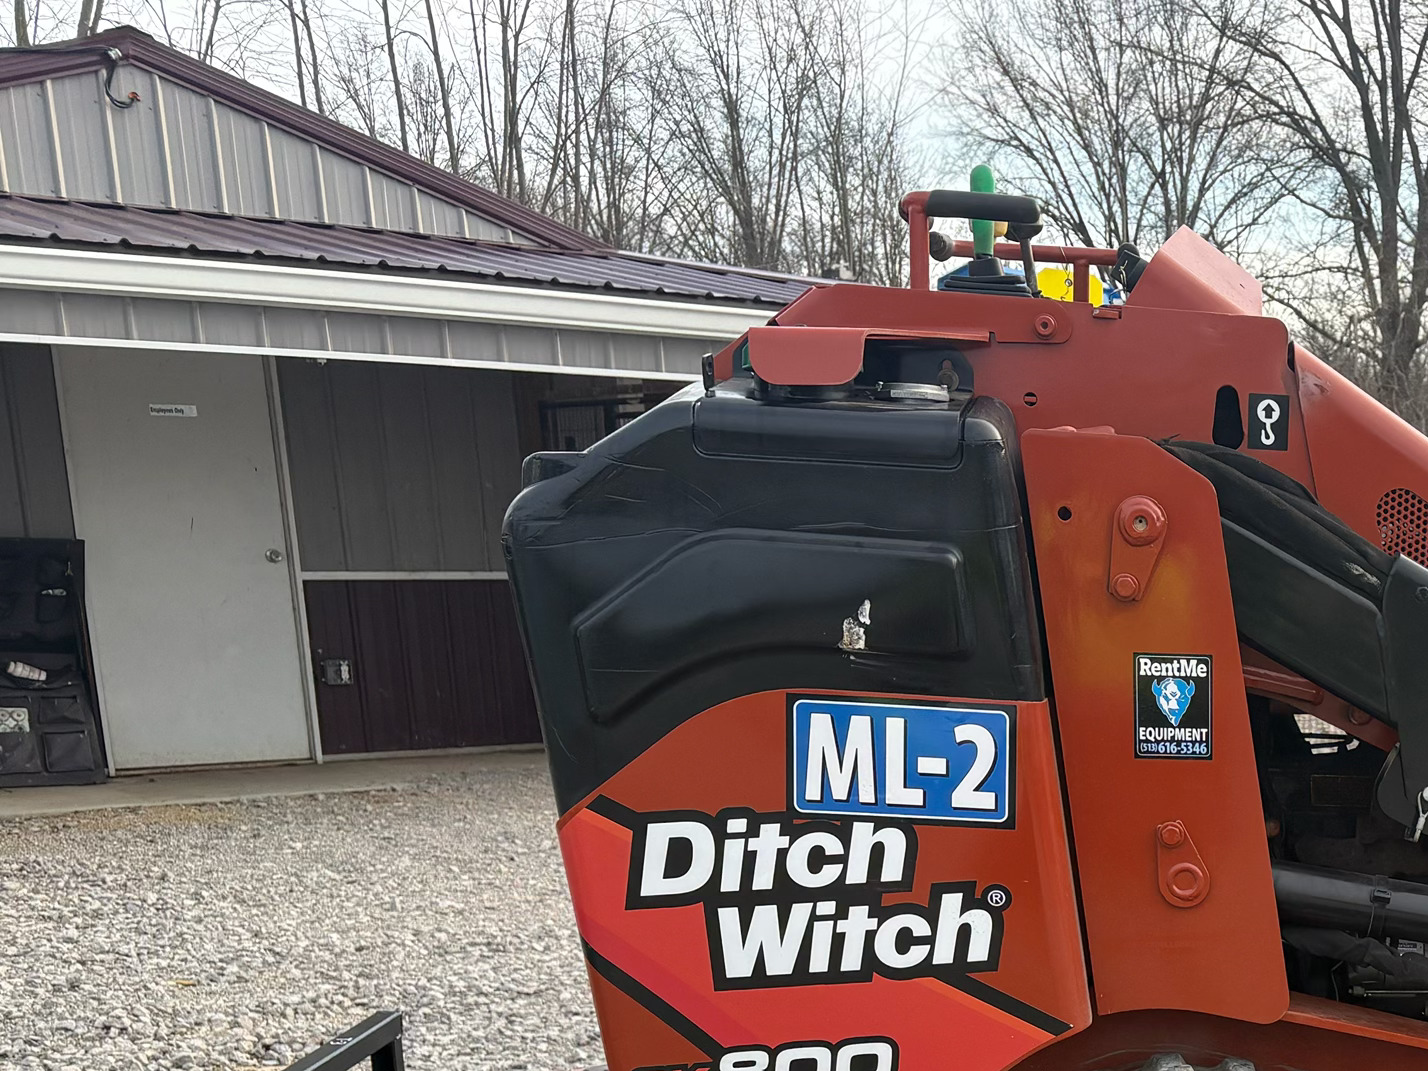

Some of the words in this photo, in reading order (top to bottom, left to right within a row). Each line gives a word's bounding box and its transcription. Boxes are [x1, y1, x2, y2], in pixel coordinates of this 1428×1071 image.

[1139, 658, 1208, 677] RentMe
[1139, 727, 1208, 742] EQUIPMENT
[805, 712, 998, 812] ML-2
[639, 817, 907, 897] Ditch
